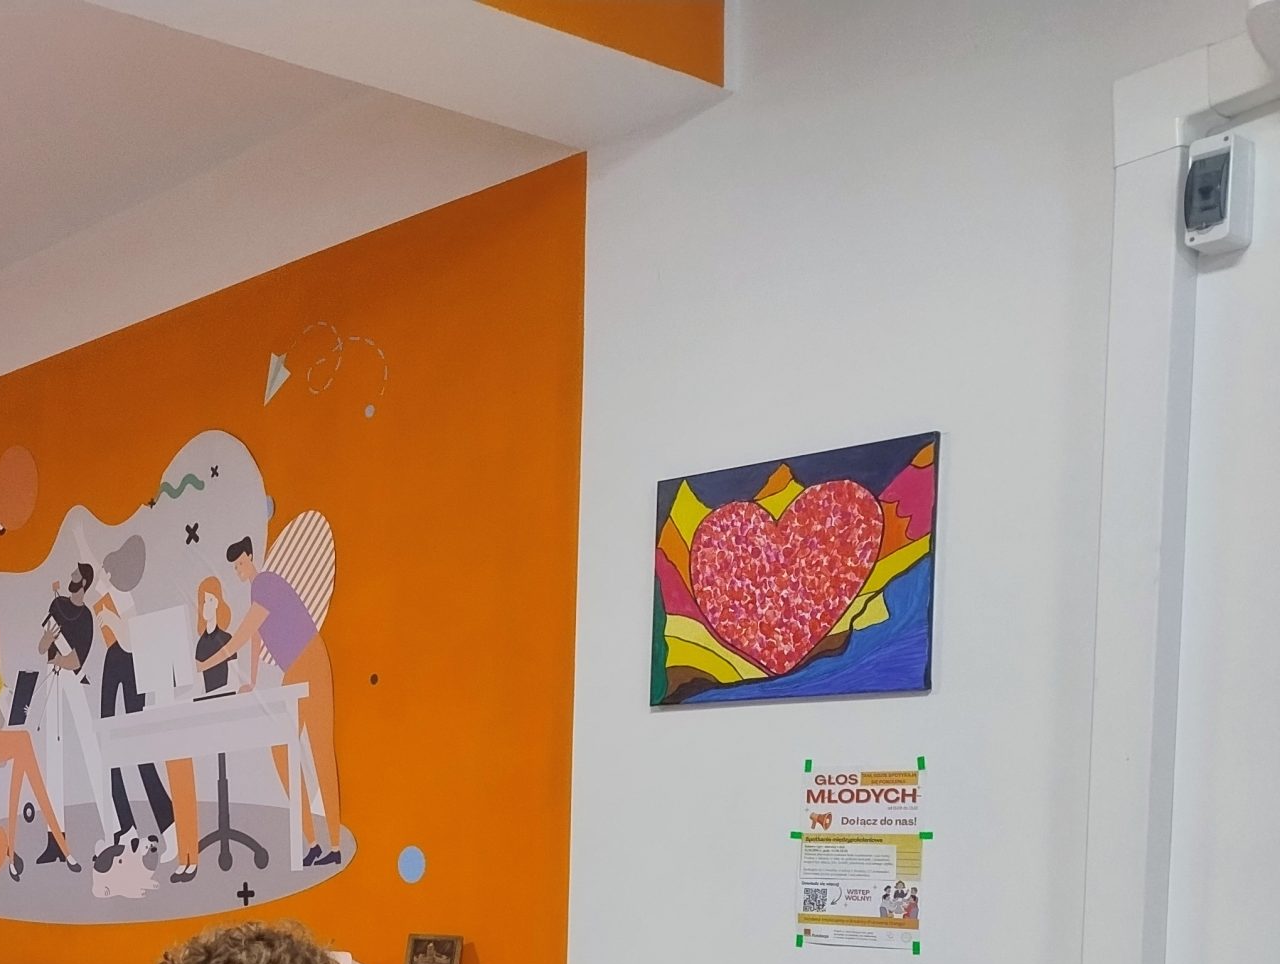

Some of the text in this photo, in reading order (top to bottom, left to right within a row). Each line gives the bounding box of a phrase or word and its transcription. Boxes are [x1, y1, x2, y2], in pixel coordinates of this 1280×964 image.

[814, 774, 859, 786] GŁOS
[806, 788, 918, 804] MŁODYCH
[880, 816, 893, 826] do
[895, 816, 917, 826] nas!
